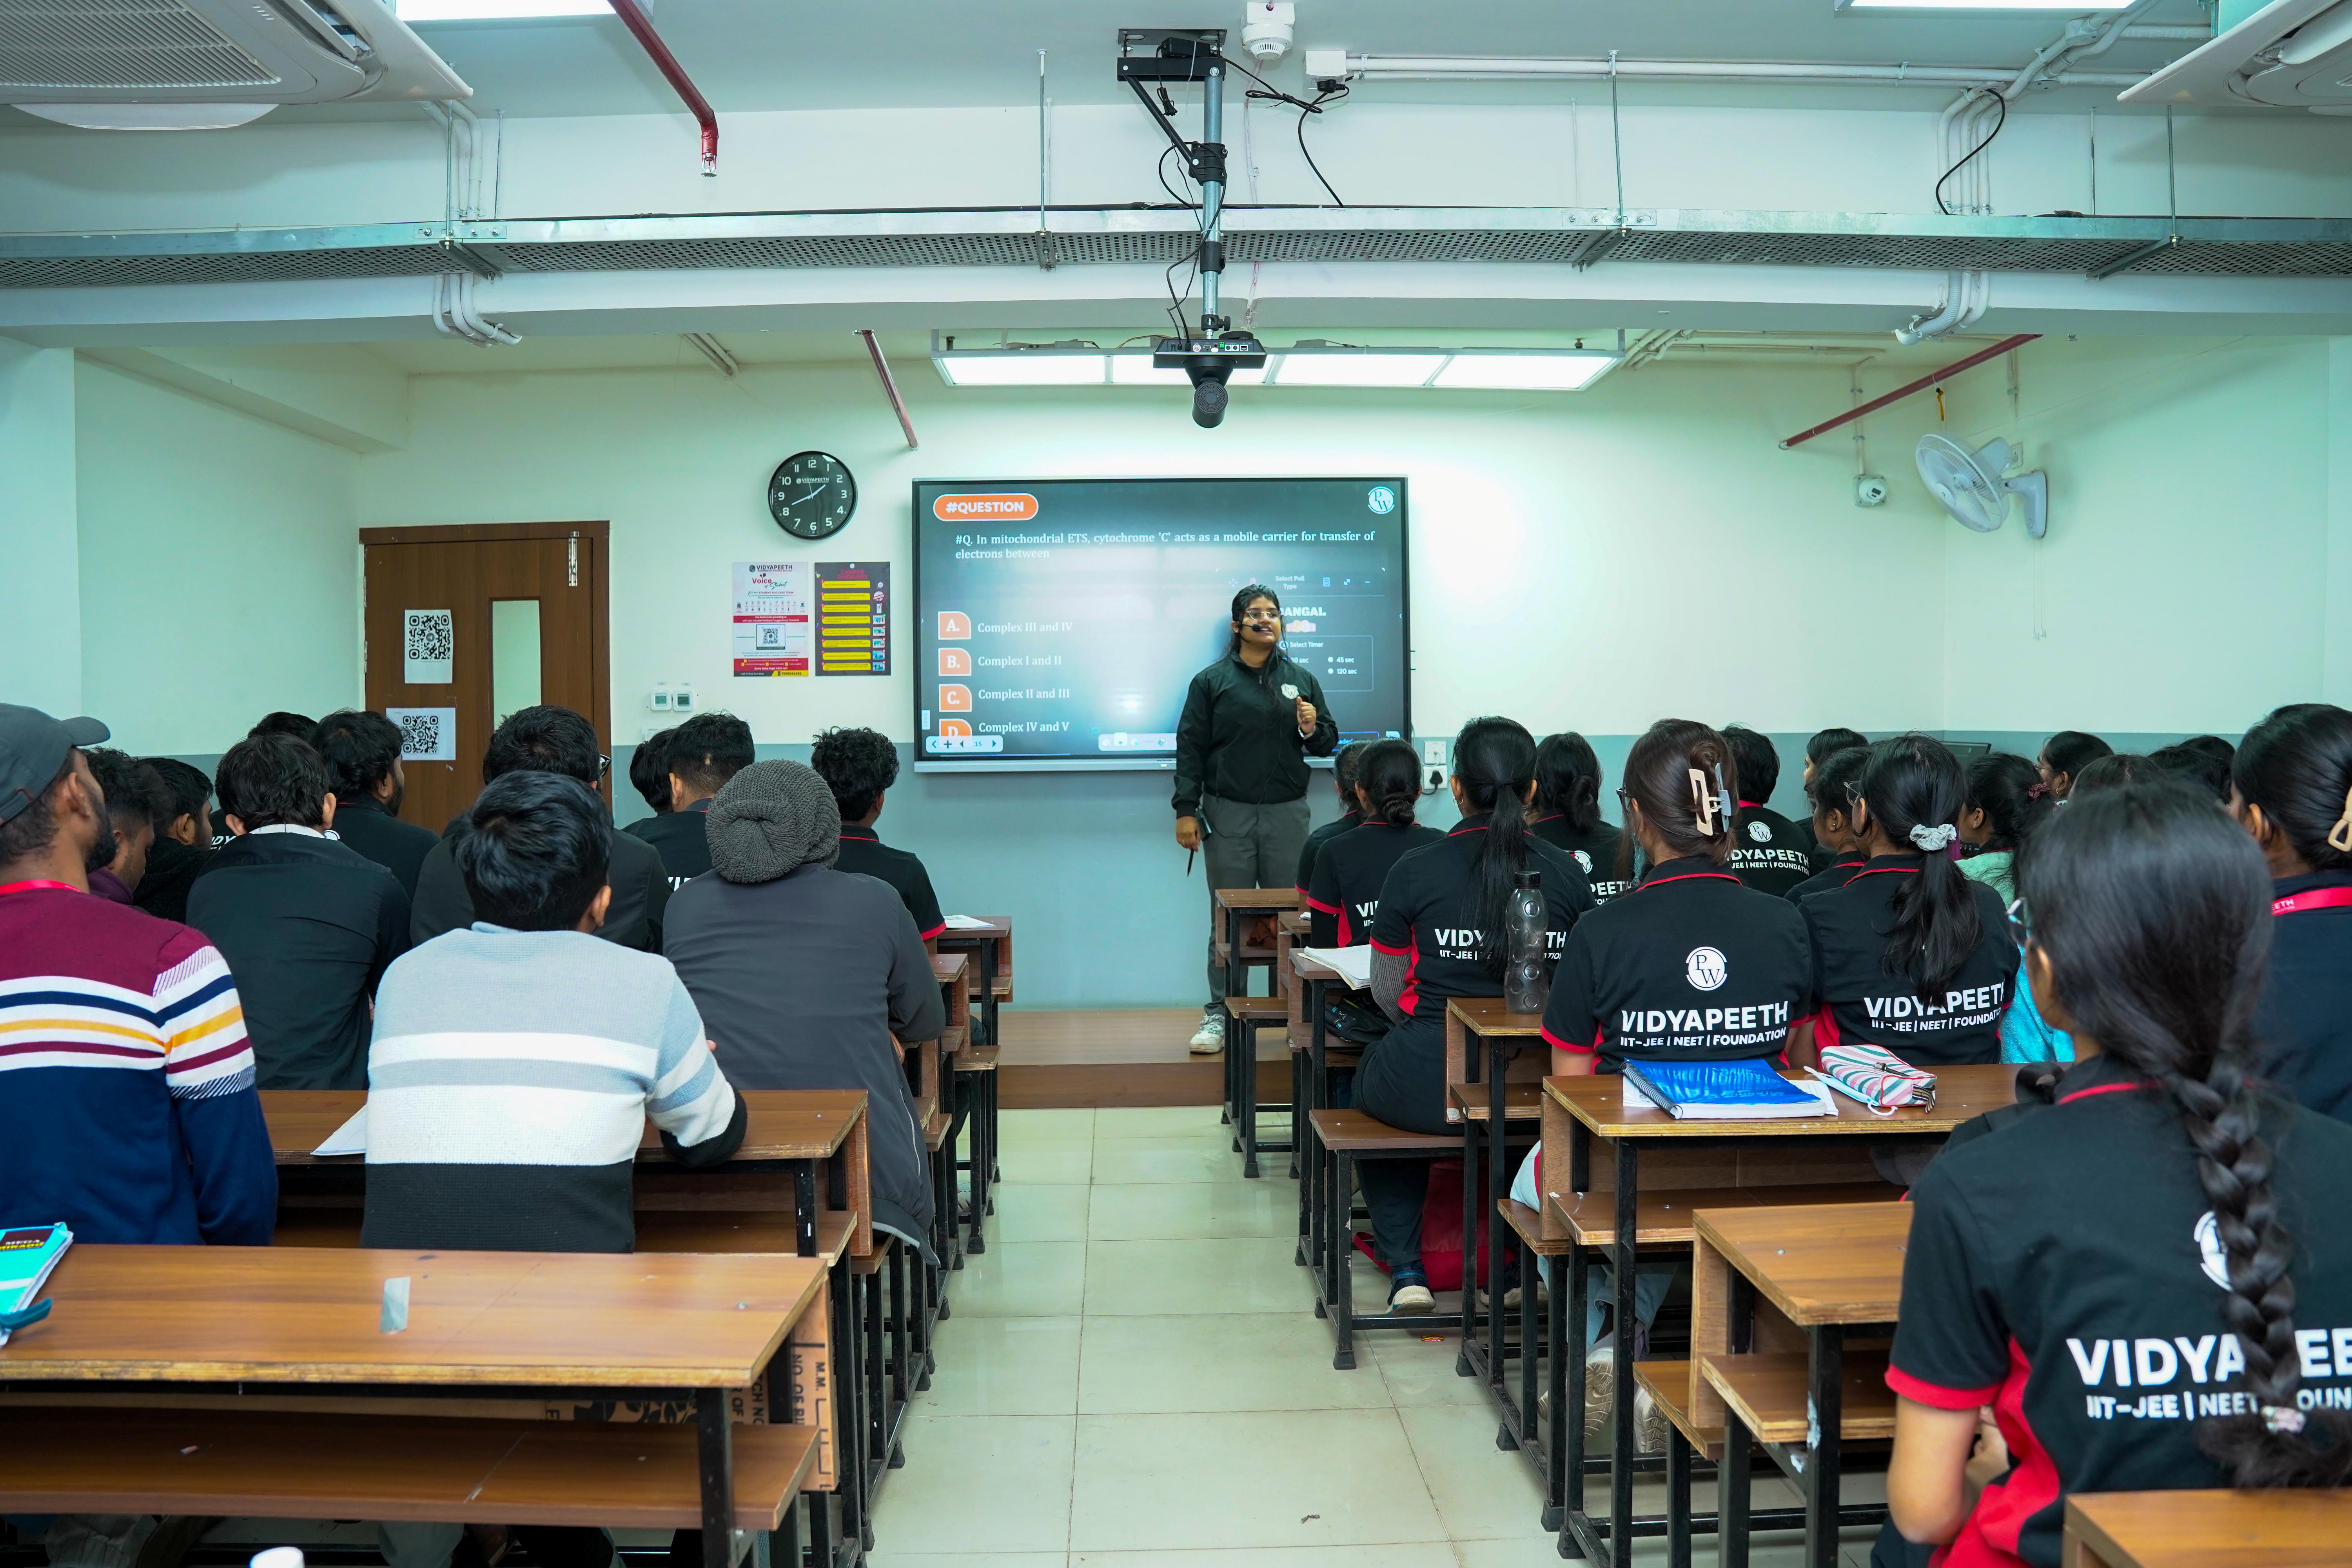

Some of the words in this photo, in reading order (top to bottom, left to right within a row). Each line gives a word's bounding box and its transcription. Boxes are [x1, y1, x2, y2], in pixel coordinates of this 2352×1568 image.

[795, 464, 799, 472] 11
[808, 460, 817, 468] 12
[827, 463, 829, 472] 1
[782, 477, 791, 485] 10
[837, 475, 843, 483] 2
[778, 492, 785, 500] 9
[841, 490, 847, 498] 3
[782, 507, 789, 515] 8
[837, 506, 844, 514] 4
[946, 502, 1024, 514] #QUESTION
[794, 519, 800, 527] 7
[810, 522, 817, 530] 6
[826, 517, 832, 526] 5
[956, 535, 973, 545] #Q.
[977, 535, 987, 544] In
[991, 533, 1063, 544] mitochondrial
[1068, 534, 1090, 544] ETS,
[1094, 533, 1154, 546] cytochrome
[1159, 532, 1171, 542] 'C'
[1174, 533, 1195, 542] acts
[1223, 532, 1259, 541] mobile
[1262, 532, 1298, 541] carrier
[1301, 532, 1316, 541] for
[1320, 532, 1361, 541] transfer
[1364, 531, 1375, 541] of
[955, 550, 1003, 559] electrons
[1006, 549, 1049, 558] between
[946, 619, 960, 632] A.
[978, 622, 1022, 634] Complex
[1025, 622, 1036, 632] III
[1040, 622, 1058, 632] and
[1062, 622, 1073, 631] IV
[947, 655, 960, 668] B.
[978, 656, 1023, 668] Complex
[1025, 656, 1029, 665] I
[1032, 656, 1051, 665] and
[1054, 655, 1062, 665] II
[947, 691, 960, 704] C.
[978, 689, 1023, 701] Complex
[1026, 689, 1033, 698] II
[1036, 689, 1055, 698] and
[1058, 688, 1069, 698] III
[979, 722, 1023, 734] Complex
[1026, 722, 1037, 731] IV
[1040, 722, 1059, 731] and
[1062, 722, 1070, 731] V
[1725, 849, 1809, 868] DYAPEETH
[1774, 862, 1809, 877] FOUNDATION
[1440, 950, 1472, 959] IIT-JEE
[1621, 1000, 1788, 1033] VIDYAPEETH
[1871, 1019, 1912, 1032] IIT-JEE
[1920, 1019, 1947, 1031] NEET
[1620, 1036, 1664, 1047] IIT-JEE
[1673, 1036, 1704, 1046] NEET
[1713, 1026, 1786, 1045] FOUNDATION
[792, 1353, 803, 1375] NO
[815, 1362, 826, 1391] M.M.
[793, 1383, 804, 1404] OF
[732, 1397, 743, 1417] OF
[2086, 1394, 2180, 1420] IIT-JEE
[2199, 1392, 2259, 1417] NEET
